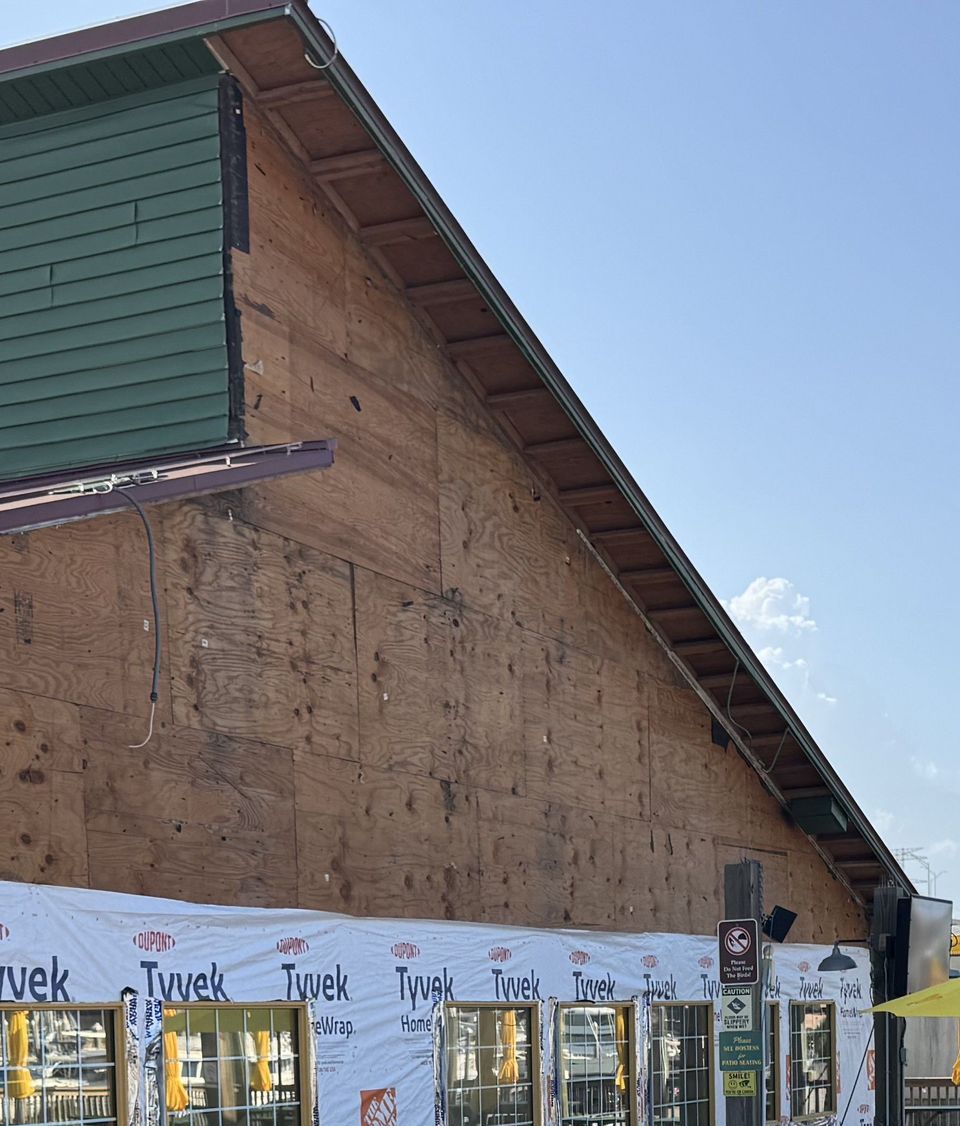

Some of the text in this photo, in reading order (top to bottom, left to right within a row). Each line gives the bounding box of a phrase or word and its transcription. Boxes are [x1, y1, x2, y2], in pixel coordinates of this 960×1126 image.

[137, 930, 173, 952] DUPONT
[140, 960, 228, 1001] Tyvek
[281, 963, 350, 1001] Tyvek
[395, 966, 454, 1011] Tyvek
[492, 969, 540, 1001] Tyvek
[572, 971, 616, 1001] Tyvek
[643, 973, 677, 1001] Tyvek
